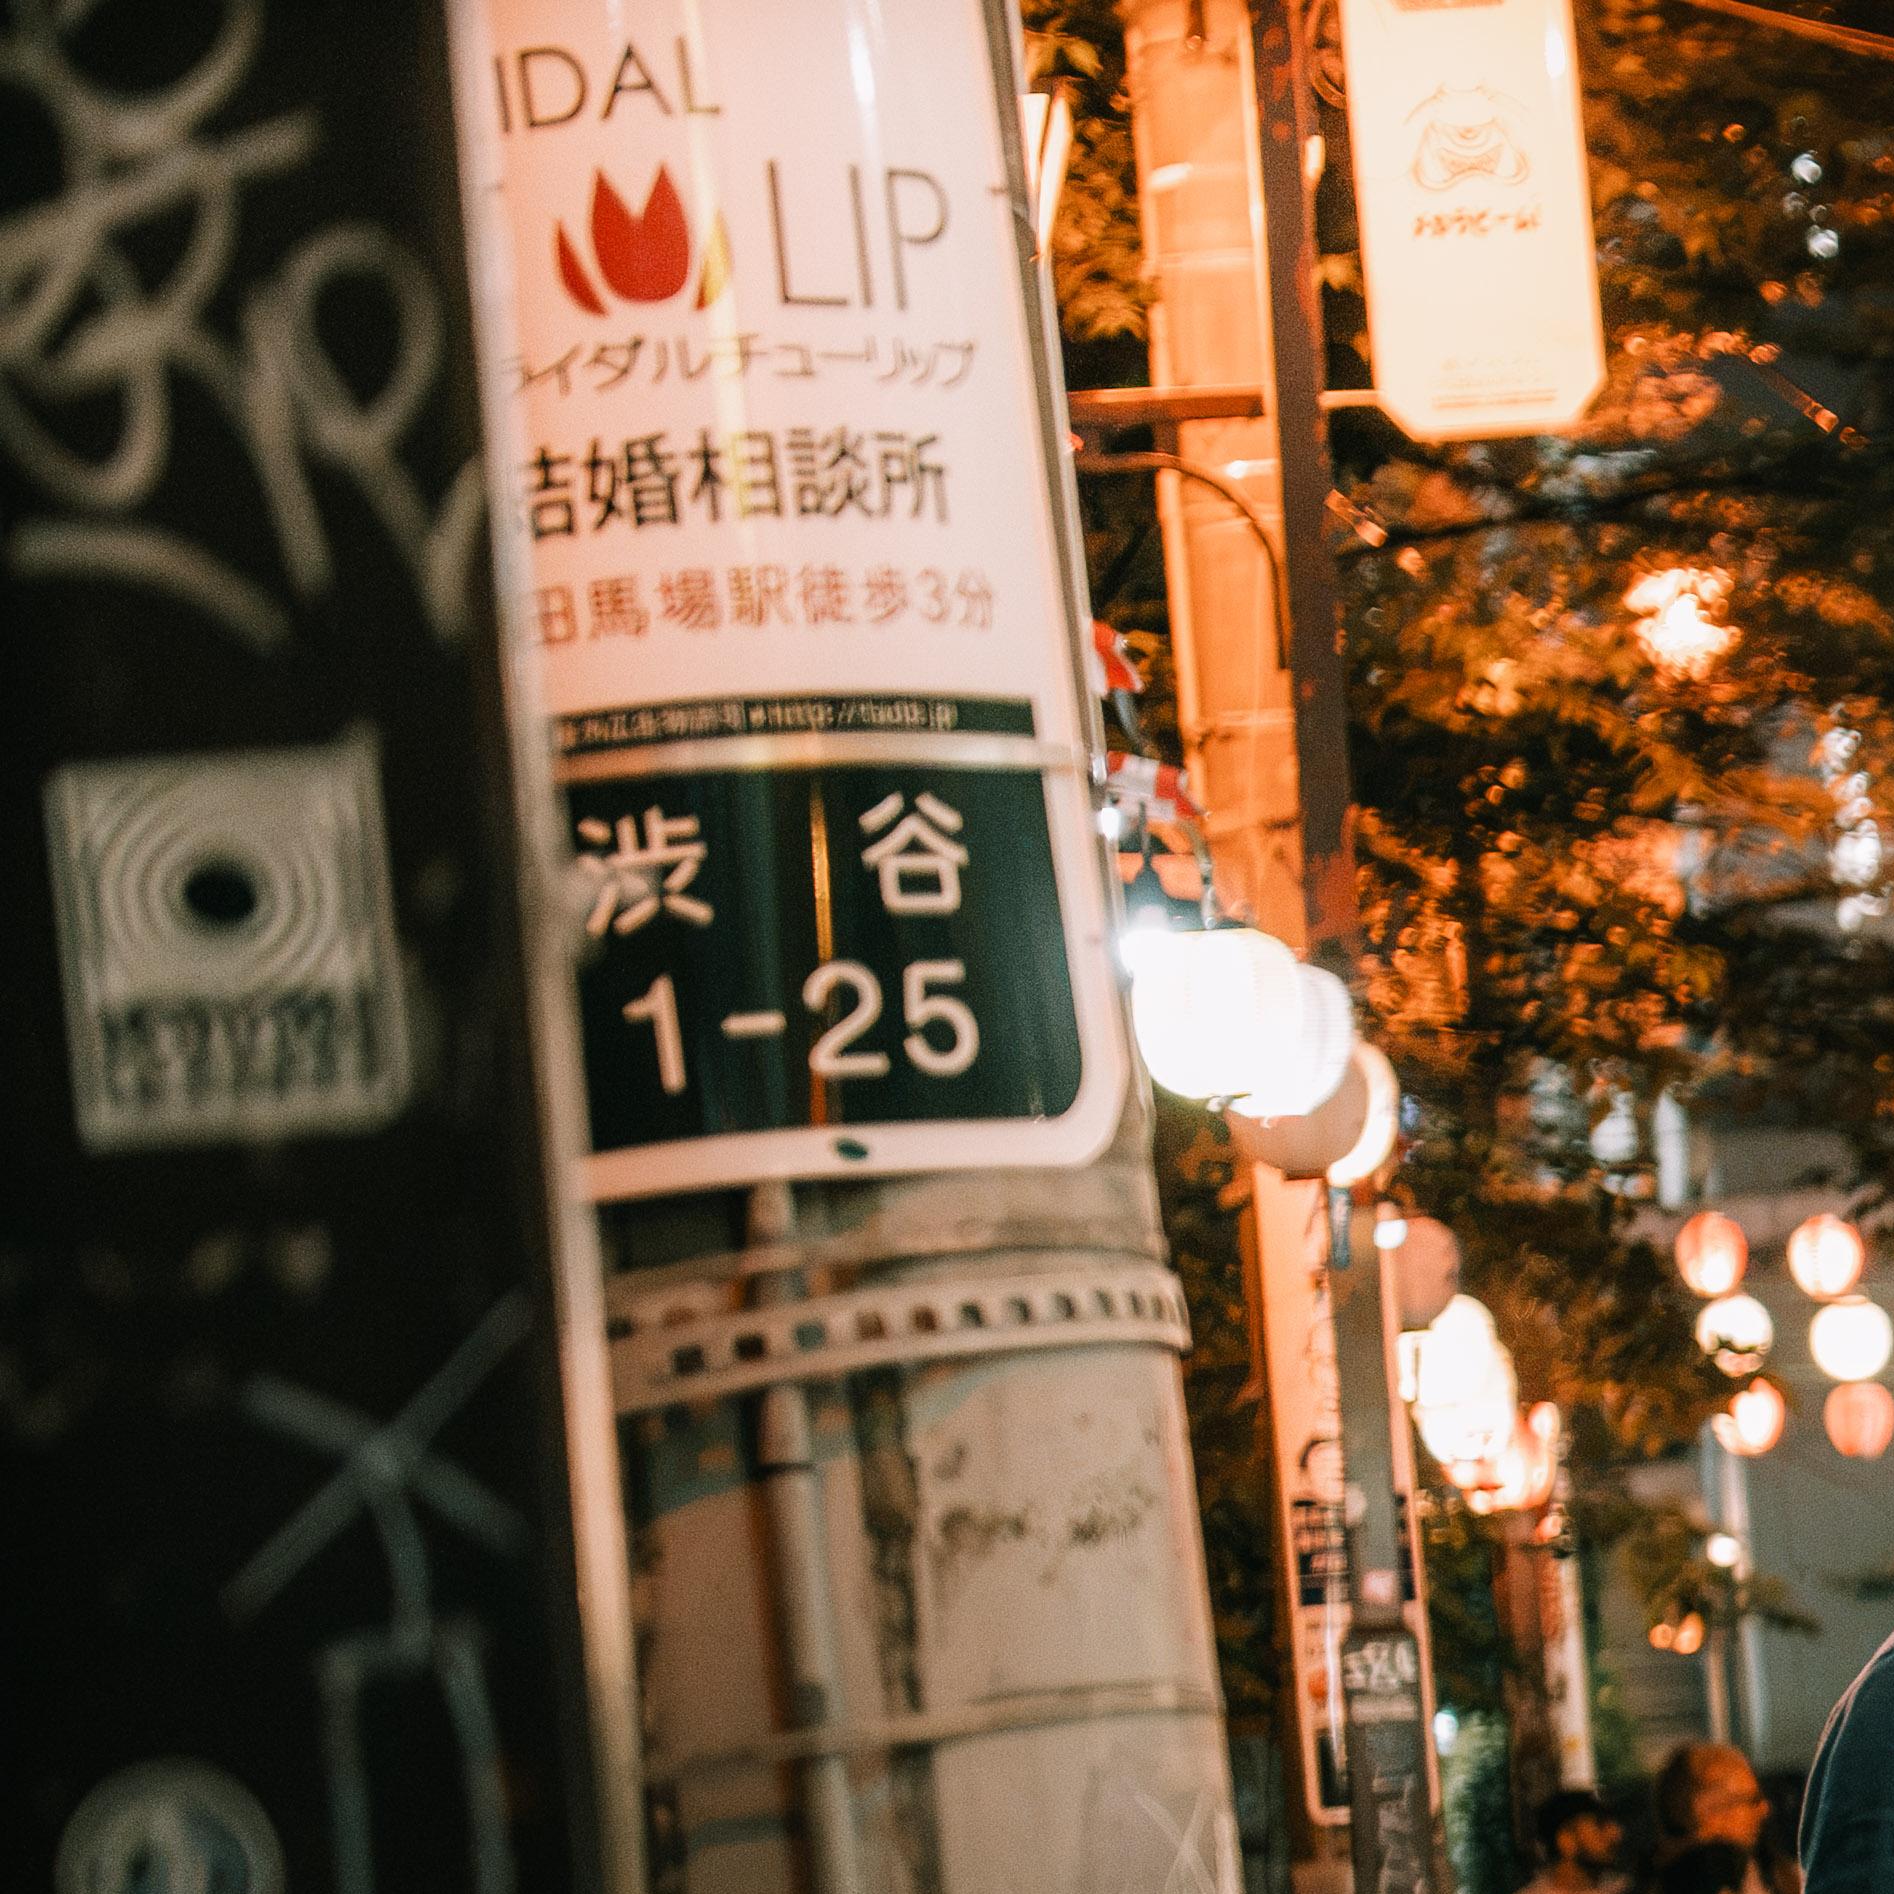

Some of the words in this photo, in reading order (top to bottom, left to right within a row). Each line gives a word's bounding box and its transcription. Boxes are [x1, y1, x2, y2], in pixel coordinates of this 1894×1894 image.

[493, 33, 722, 134] IDAL
[765, 158, 950, 312] LIP
[577, 791, 969, 937] 渋谷
[622, 960, 981, 1095] 1-25
